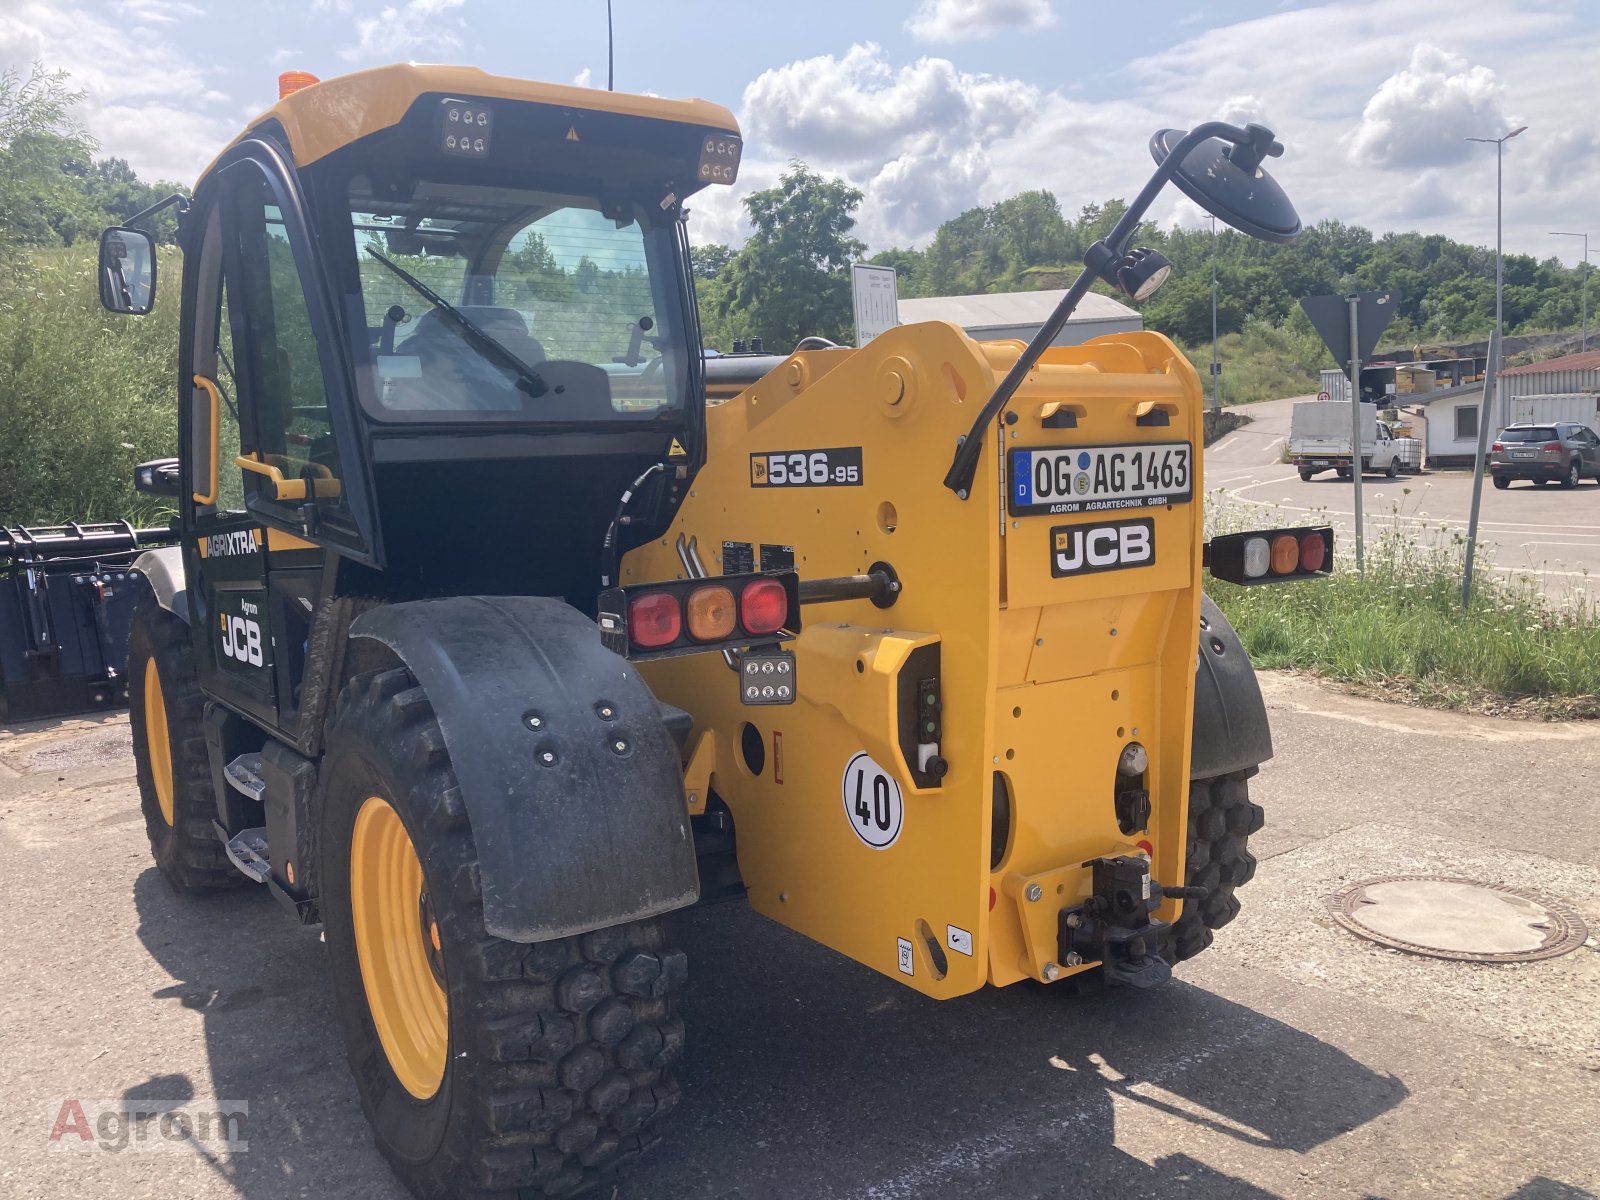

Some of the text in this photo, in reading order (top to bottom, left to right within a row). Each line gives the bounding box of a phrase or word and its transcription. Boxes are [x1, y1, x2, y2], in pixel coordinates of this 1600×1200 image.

[1035, 455, 1071, 498] OG
[1093, 453, 1125, 495] AG
[1131, 450, 1187, 491] 1463
[1050, 497, 1168, 513] AGROM AGRARTECHNIK GMBH
[207, 529, 258, 558] AGRIXTRA
[1056, 525, 1150, 570] JCB
[241, 597, 258, 616] Agrom
[222, 614, 263, 668] JCB
[855, 769, 891, 832] 40
